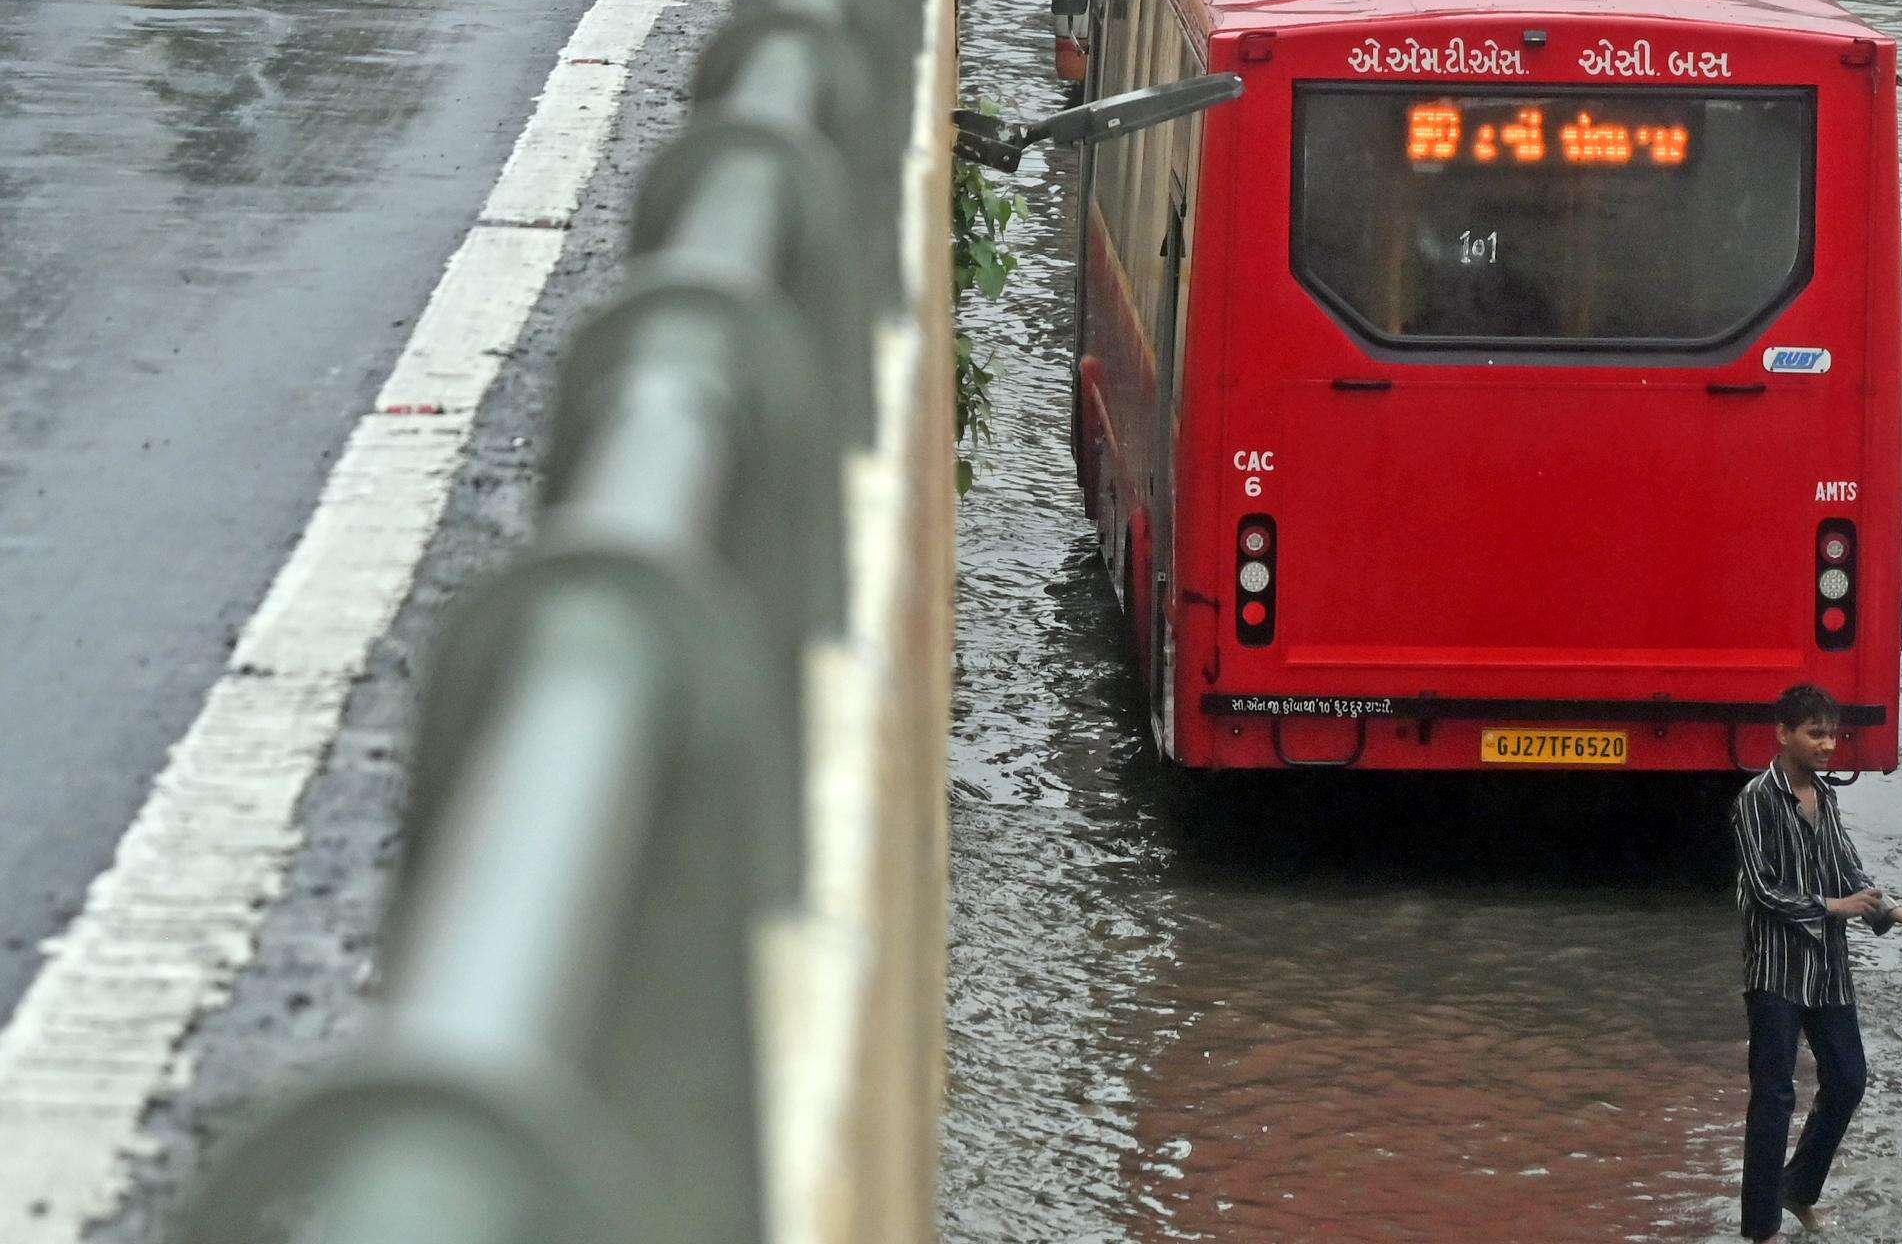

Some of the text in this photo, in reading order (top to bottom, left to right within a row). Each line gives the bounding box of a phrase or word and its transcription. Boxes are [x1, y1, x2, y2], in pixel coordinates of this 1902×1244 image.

[1668, 51, 1731, 77] બસ
[1772, 351, 1823, 369] RUBY
[1234, 451, 1274, 471] CAC
[1245, 477, 1261, 497] 6
[1815, 481, 1858, 501] AMTS
[1497, 736, 1624, 757] GJ27TF6520
